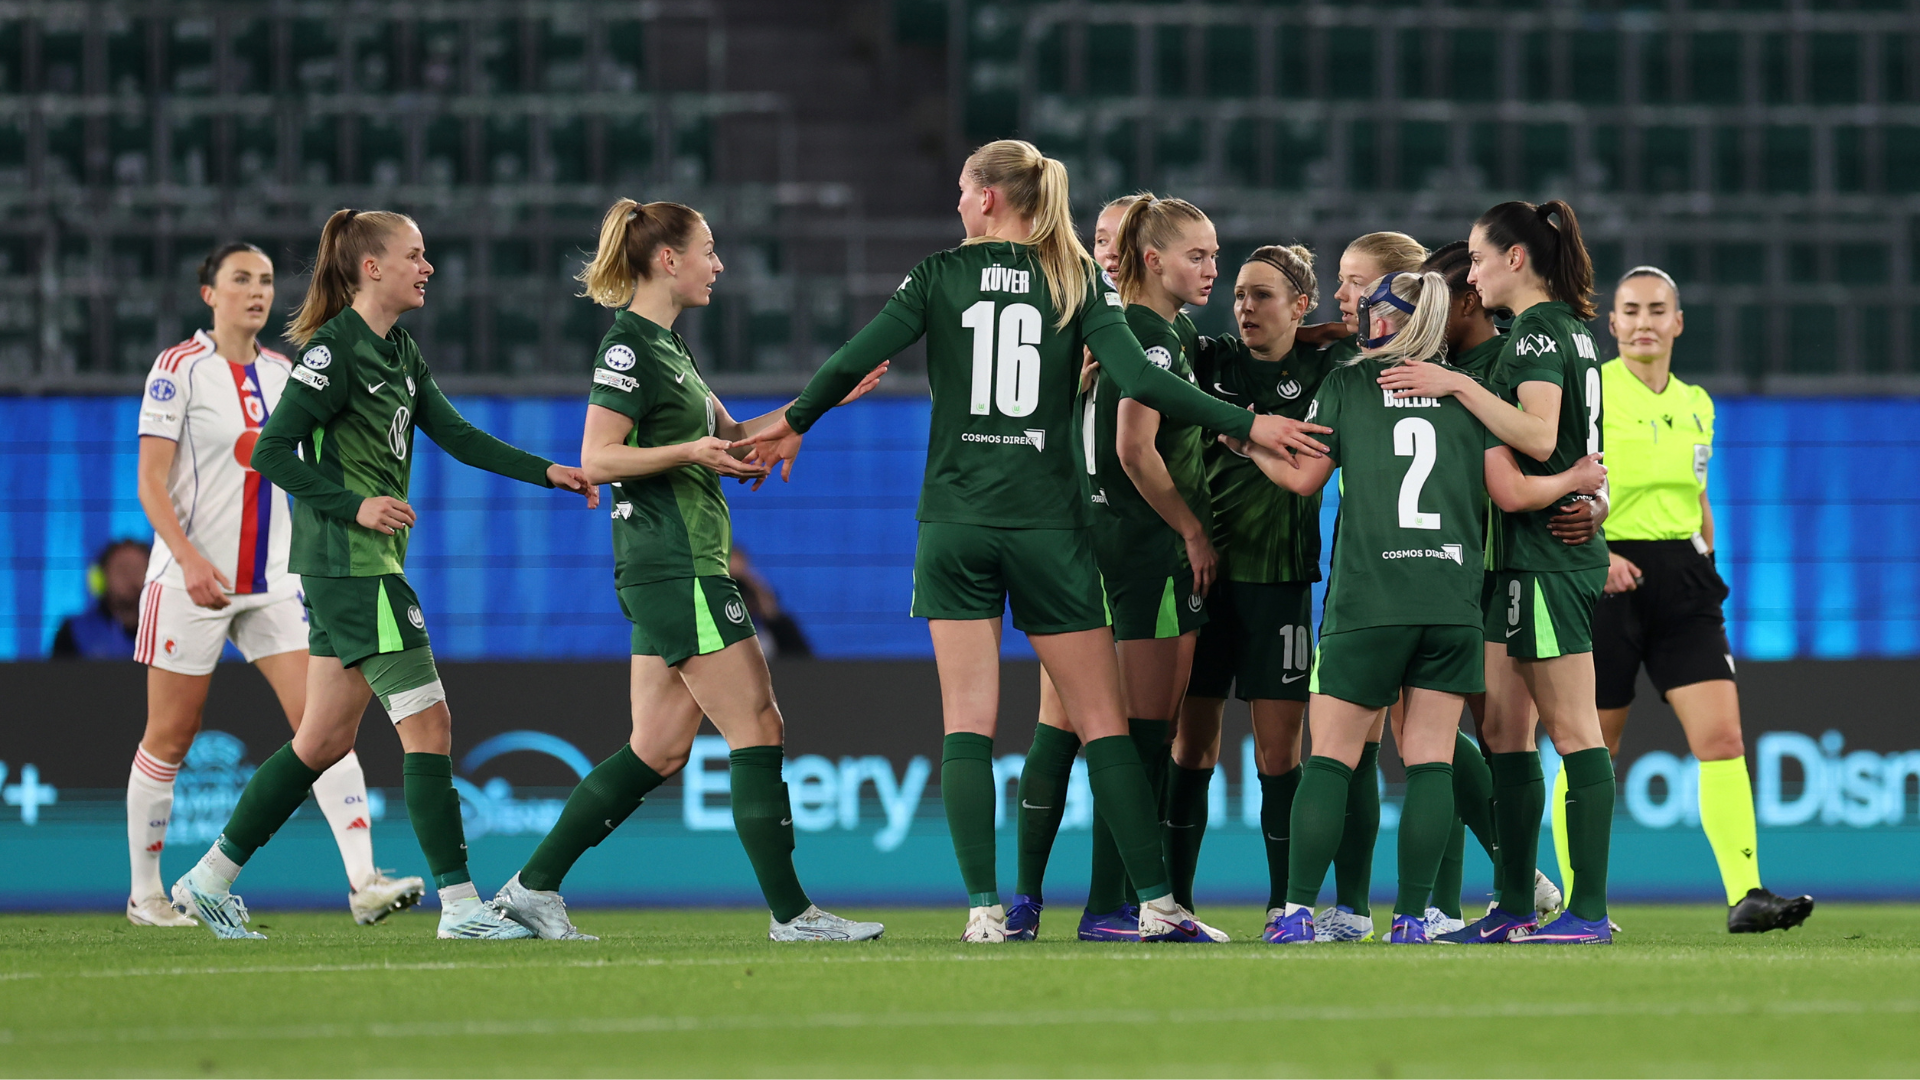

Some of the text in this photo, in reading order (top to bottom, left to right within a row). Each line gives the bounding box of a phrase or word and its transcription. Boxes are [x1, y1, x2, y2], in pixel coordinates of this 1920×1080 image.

[980, 263, 1030, 293] KÜVER
[961, 300, 1043, 418] 16
[1586, 367, 1601, 458] 3
[961, 433, 1038, 446] COSMOS DIREKT
[1393, 416, 1441, 530] 2
[1382, 549, 1457, 561] COSMOS DIREKT
[1507, 579, 1521, 626] 3
[1279, 624, 1308, 671] 10
[344, 795, 364, 805] OL
[682, 734, 932, 852] Eery
